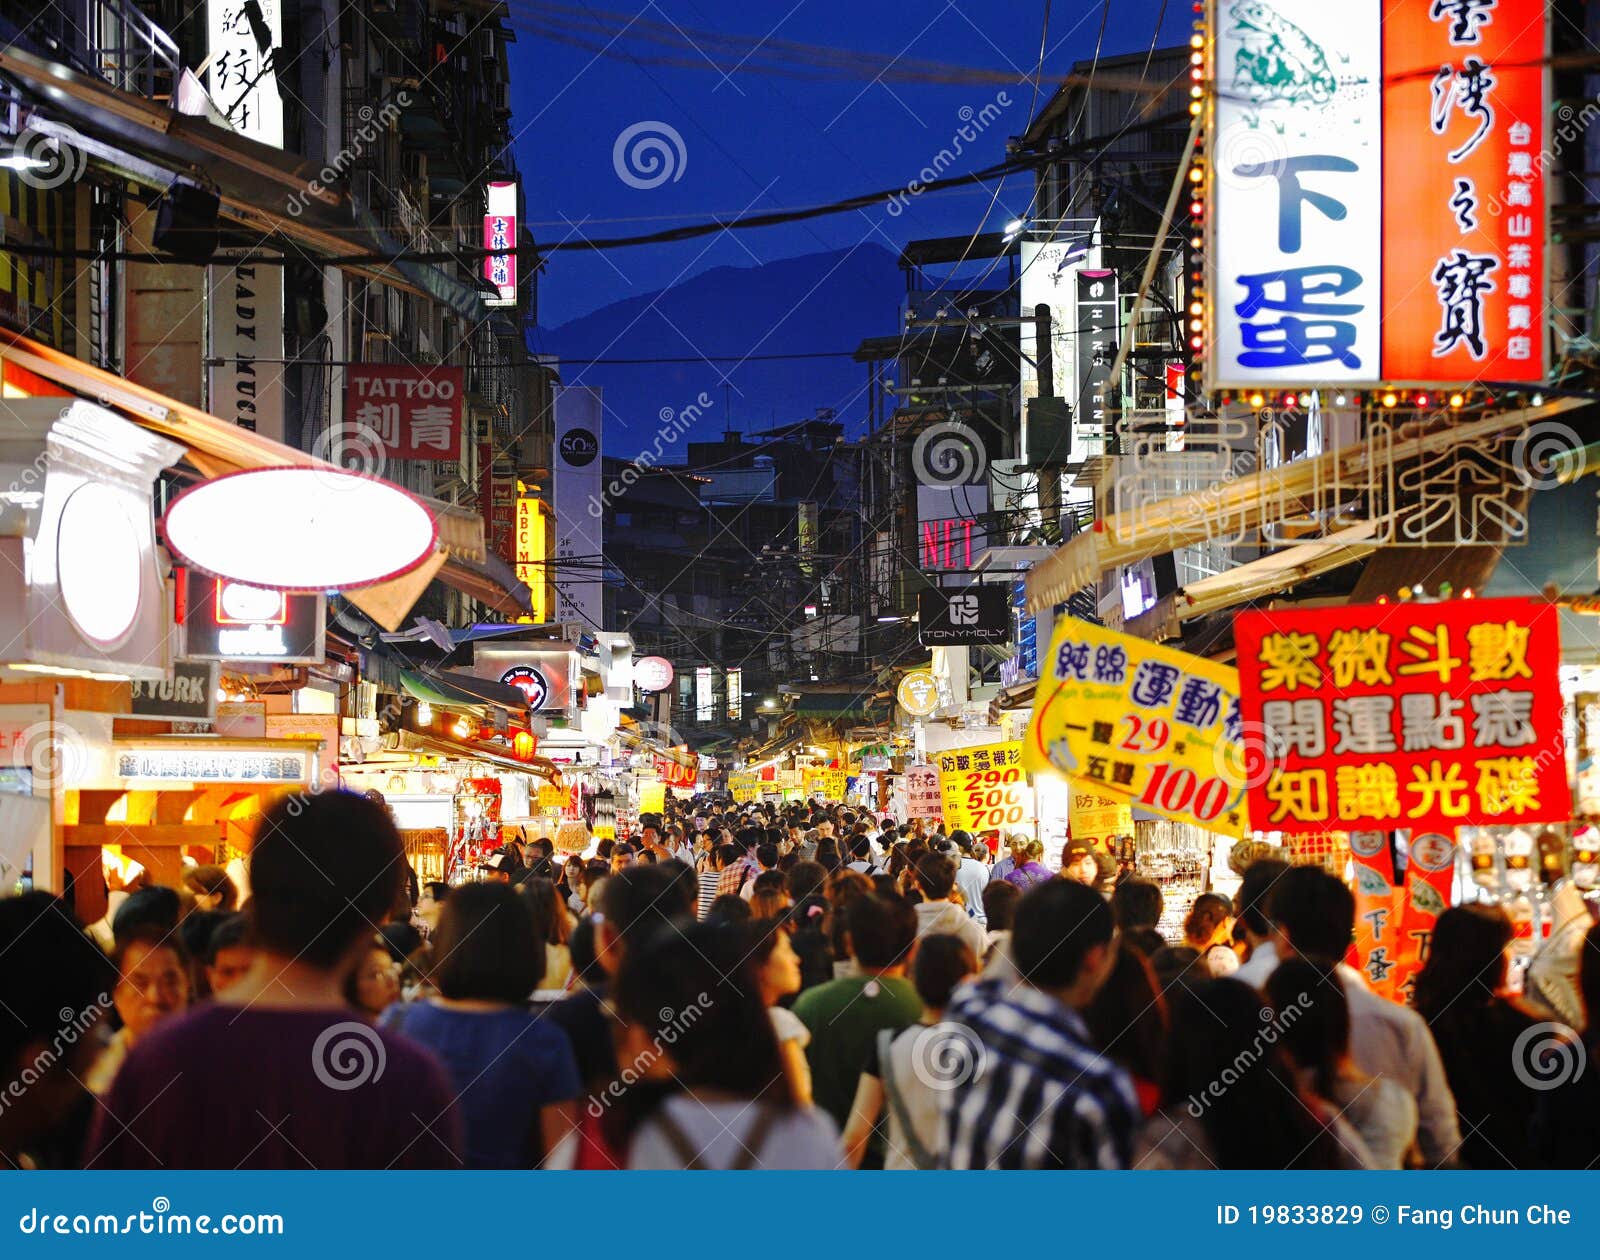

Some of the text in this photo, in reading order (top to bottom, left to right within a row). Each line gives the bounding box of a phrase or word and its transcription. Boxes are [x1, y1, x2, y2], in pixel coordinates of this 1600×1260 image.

[1232, 155, 1365, 370] 下蛋
[236, 267, 256, 341] LADY
[354, 377, 455, 399] TATTOO
[1092, 309, 1103, 420] HANG TEN
[356, 402, 453, 450] 刺青
[922, 519, 976, 568] NET
[923, 628, 1005, 638] TONYMOLY
[1259, 620, 1532, 692] 紫微斗數
[1121, 715, 1170, 751] 29
[1263, 689, 1537, 757] 開運點痣
[964, 768, 1020, 791] 290
[966, 789, 1021, 810] 500
[1139, 764, 1229, 821] 100
[1265, 757, 1541, 823] 知識光碟
[971, 806, 1024, 829] 700
[1364, 910, 1394, 981] 下蛋
